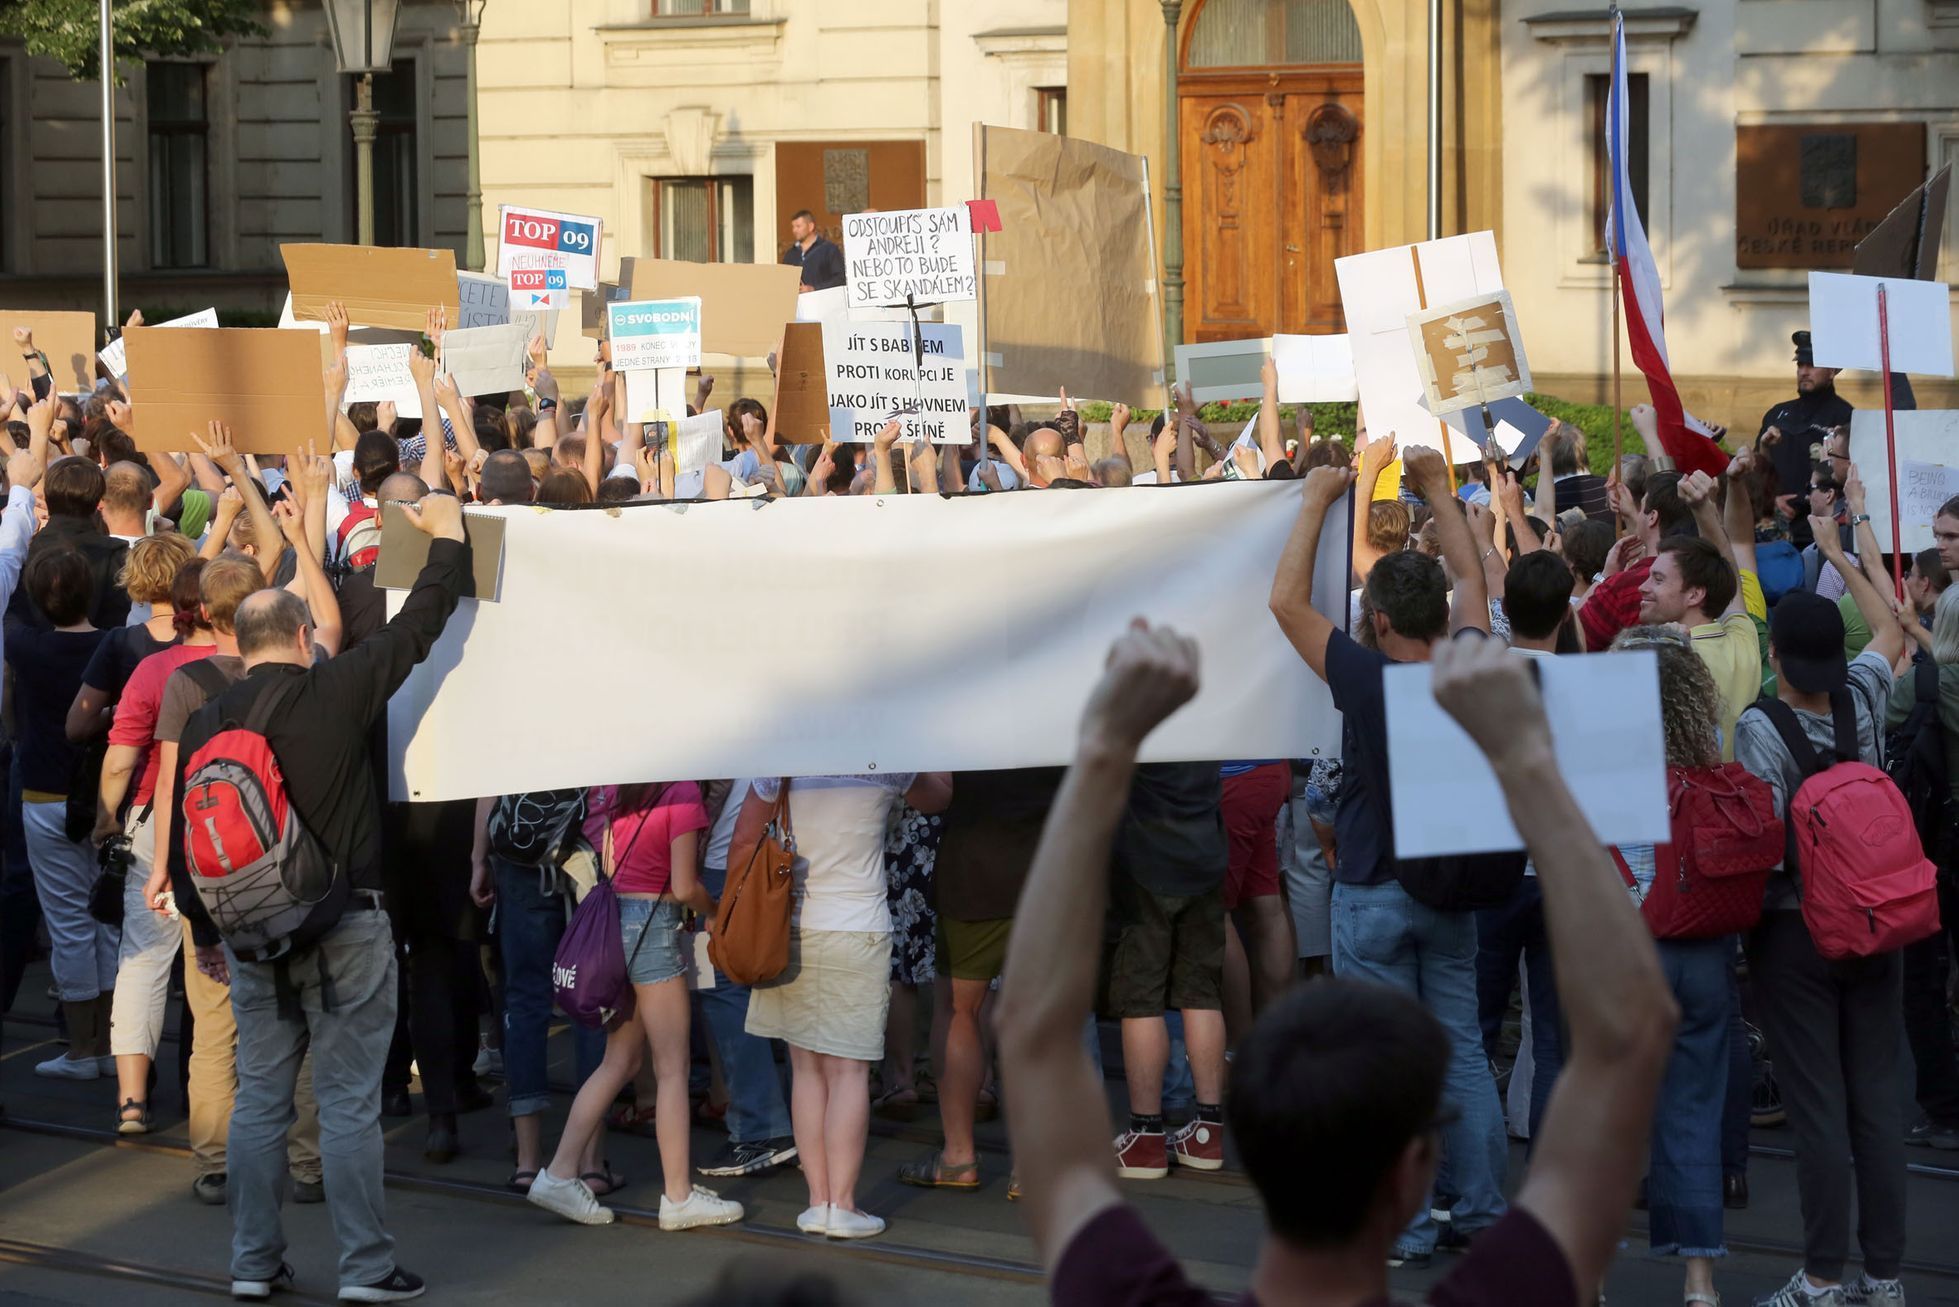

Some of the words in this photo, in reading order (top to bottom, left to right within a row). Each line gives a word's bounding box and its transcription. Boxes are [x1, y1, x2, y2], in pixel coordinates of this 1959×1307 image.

[509, 218, 556, 241] TOP
[563, 230, 589, 250] 09
[849, 213, 923, 238] ODSTOUPÍŠ
[928, 211, 959, 234] SÁM
[867, 235, 925, 256] ANDREJI
[853, 257, 894, 278] NEBO
[895, 256, 913, 275] TO
[918, 254, 958, 275] BUDE
[513, 274, 544, 286] TOP
[549, 275, 564, 288] 09
[857, 281, 879, 301] SE
[627, 309, 695, 325] SVOBODNÍ
[615, 343, 637, 352] 1989
[641, 341, 666, 351] KONEC
[847, 333, 866, 351] JÍT
[870, 338, 879, 352] S
[642, 355, 670, 365] STRANY
[837, 365, 880, 379] PROTI
[941, 367, 954, 381] JE
[830, 394, 867, 408] JAKO
[870, 392, 887, 410] JÍT
[892, 397, 900, 411] S
